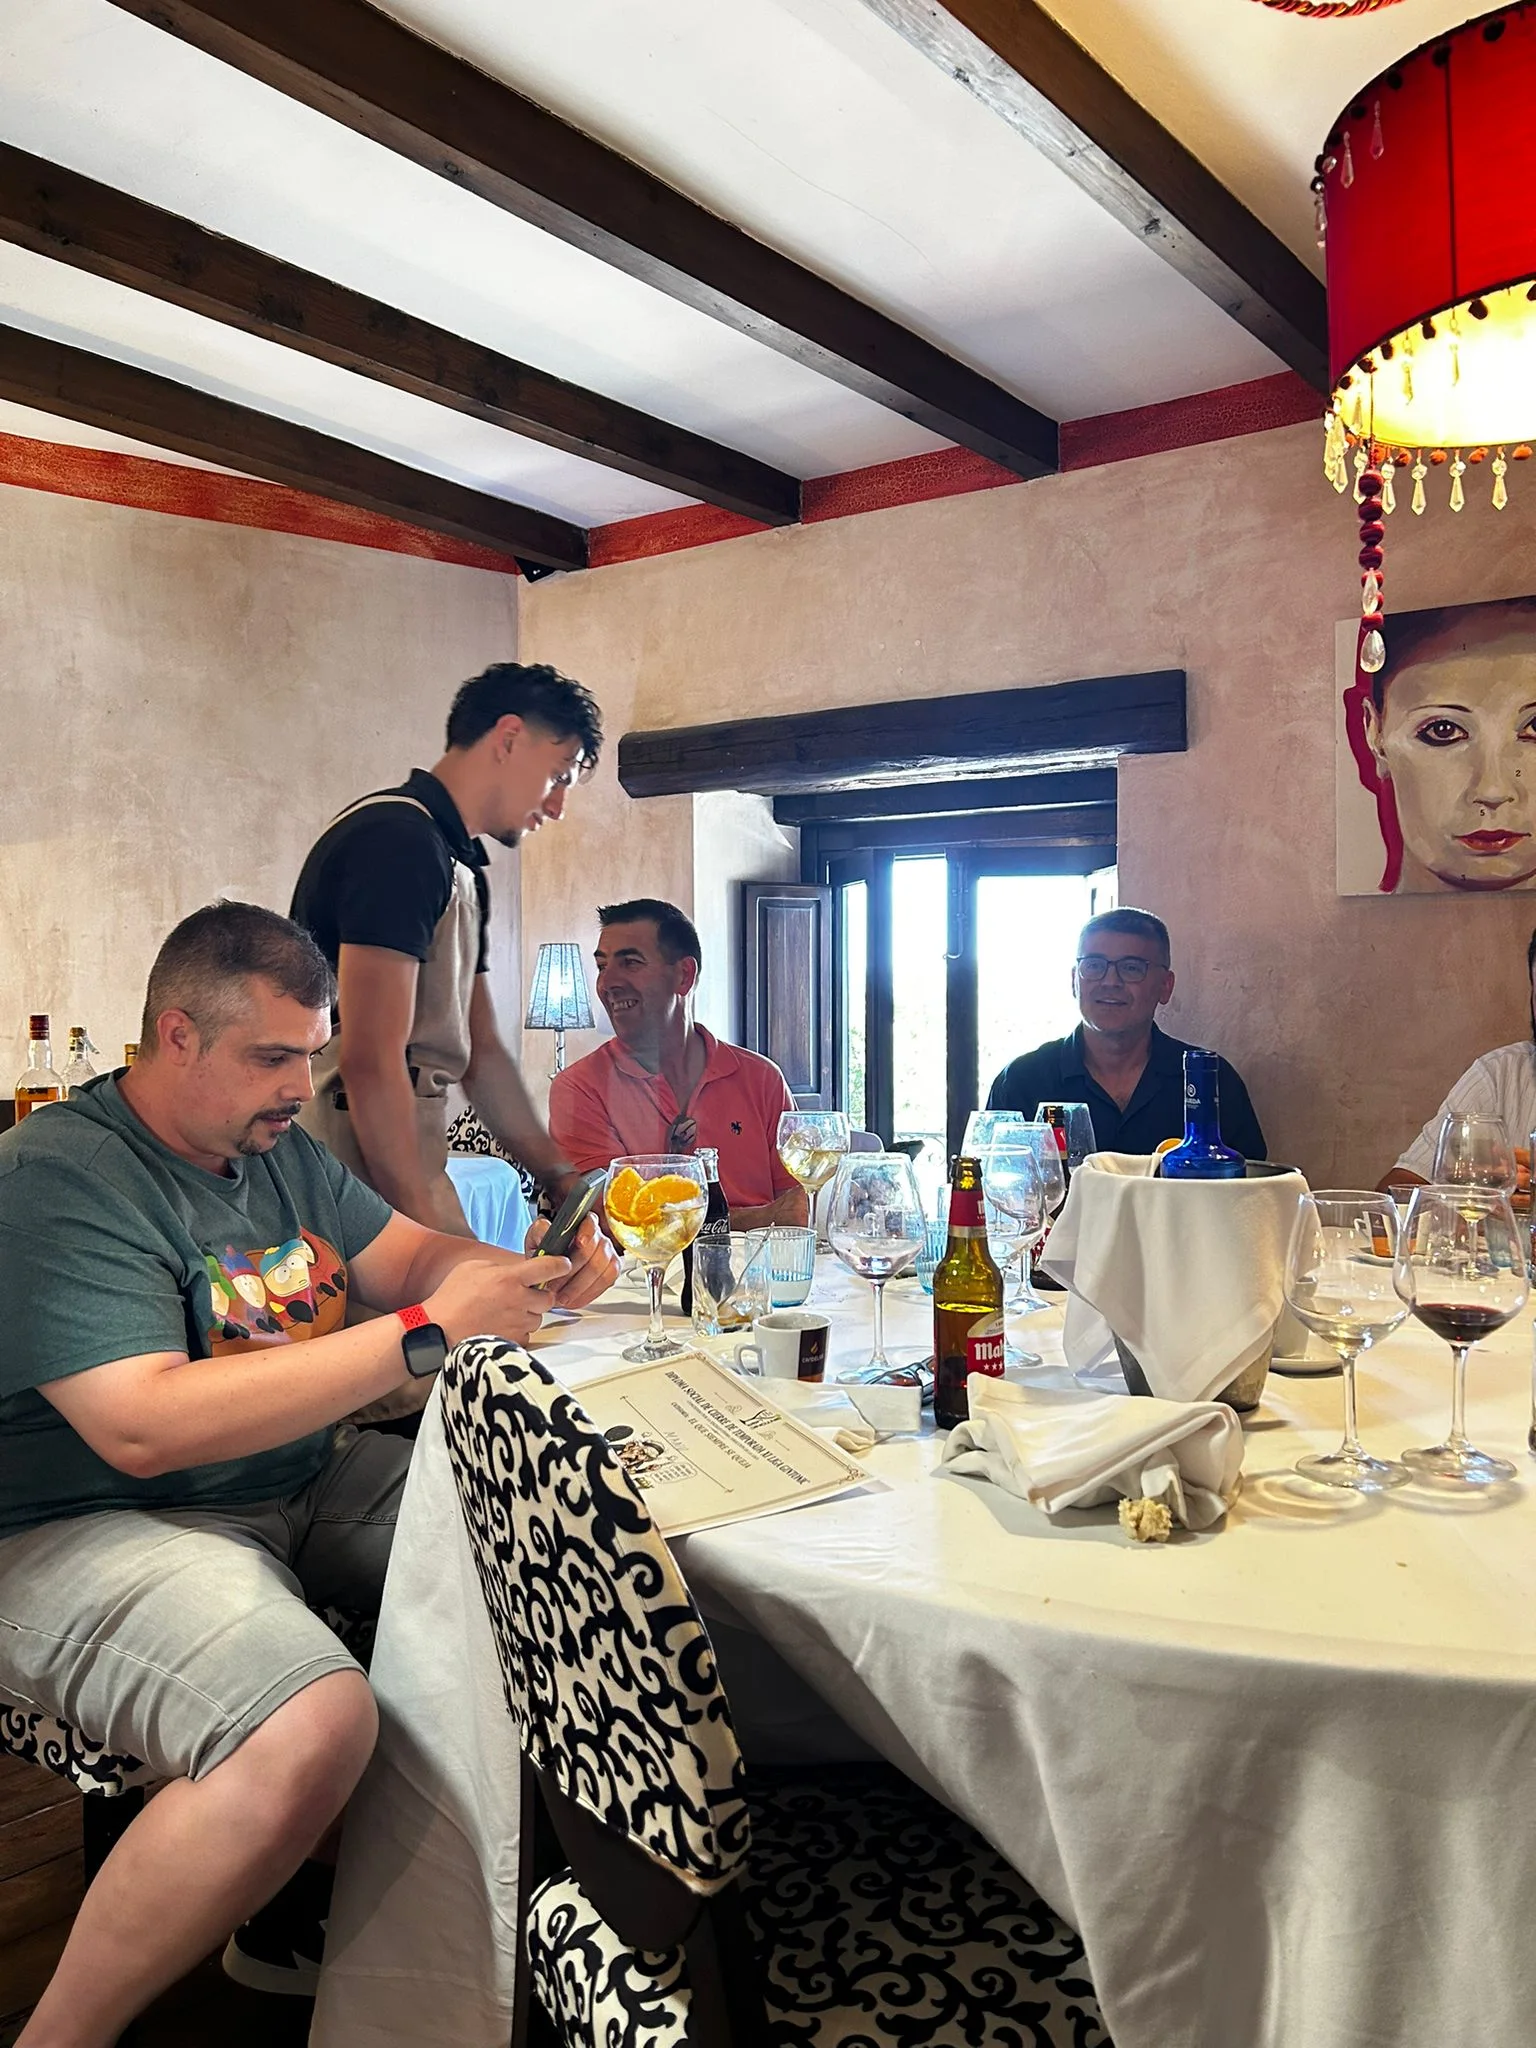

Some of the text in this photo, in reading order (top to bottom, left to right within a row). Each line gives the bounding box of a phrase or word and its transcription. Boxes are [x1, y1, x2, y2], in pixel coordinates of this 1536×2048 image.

[1515, 769, 1521, 778] 2
[1480, 809, 1486, 817] 5
[683, 1386, 706, 1405] SOCIAL
[705, 1408, 731, 1424] CIERRE
